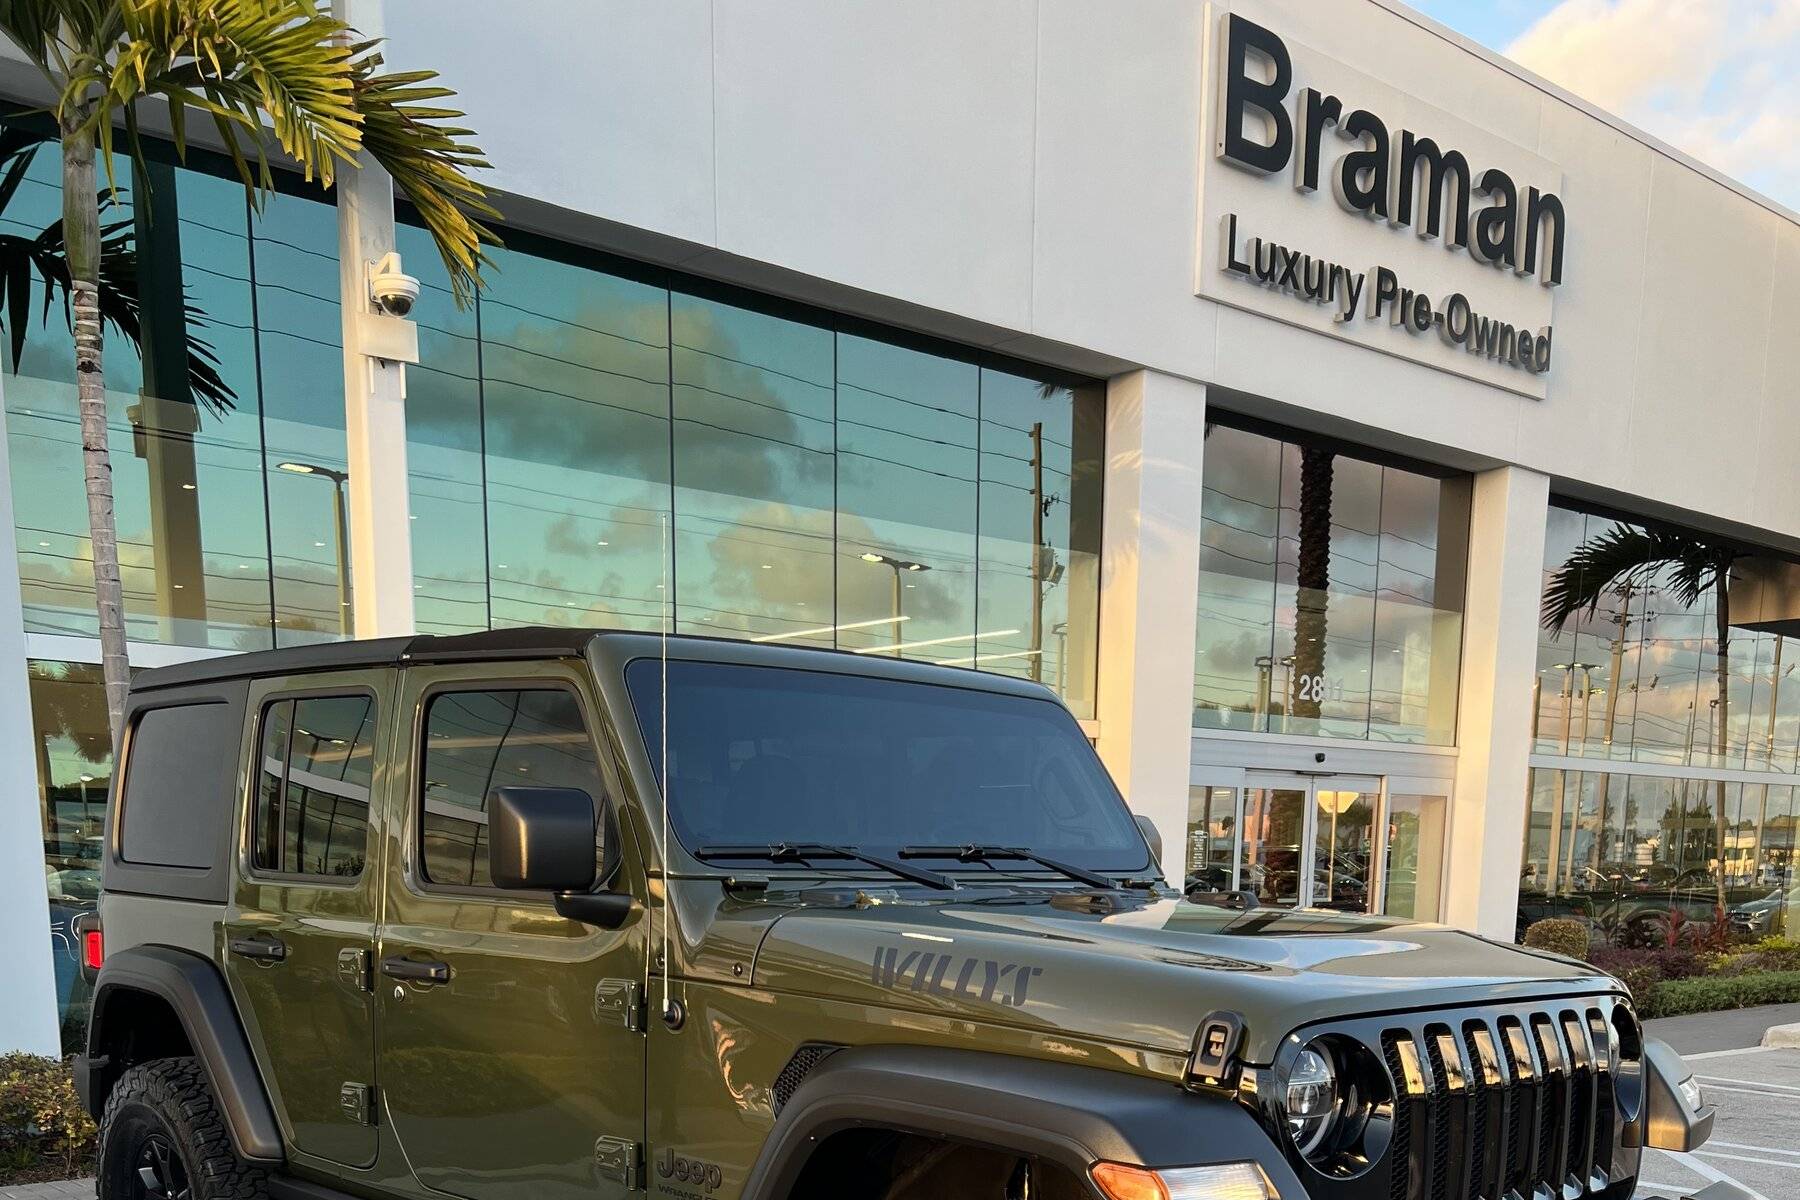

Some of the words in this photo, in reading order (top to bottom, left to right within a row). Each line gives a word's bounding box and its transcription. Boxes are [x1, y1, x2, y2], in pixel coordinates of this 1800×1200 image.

[1217, 12, 1566, 287] Braman
[1219, 213, 1364, 322] Luxury
[1367, 266, 1552, 373] Pre-Owned
[872, 946, 1043, 1007] WILLYS
[657, 1148, 722, 1194] Jeep
